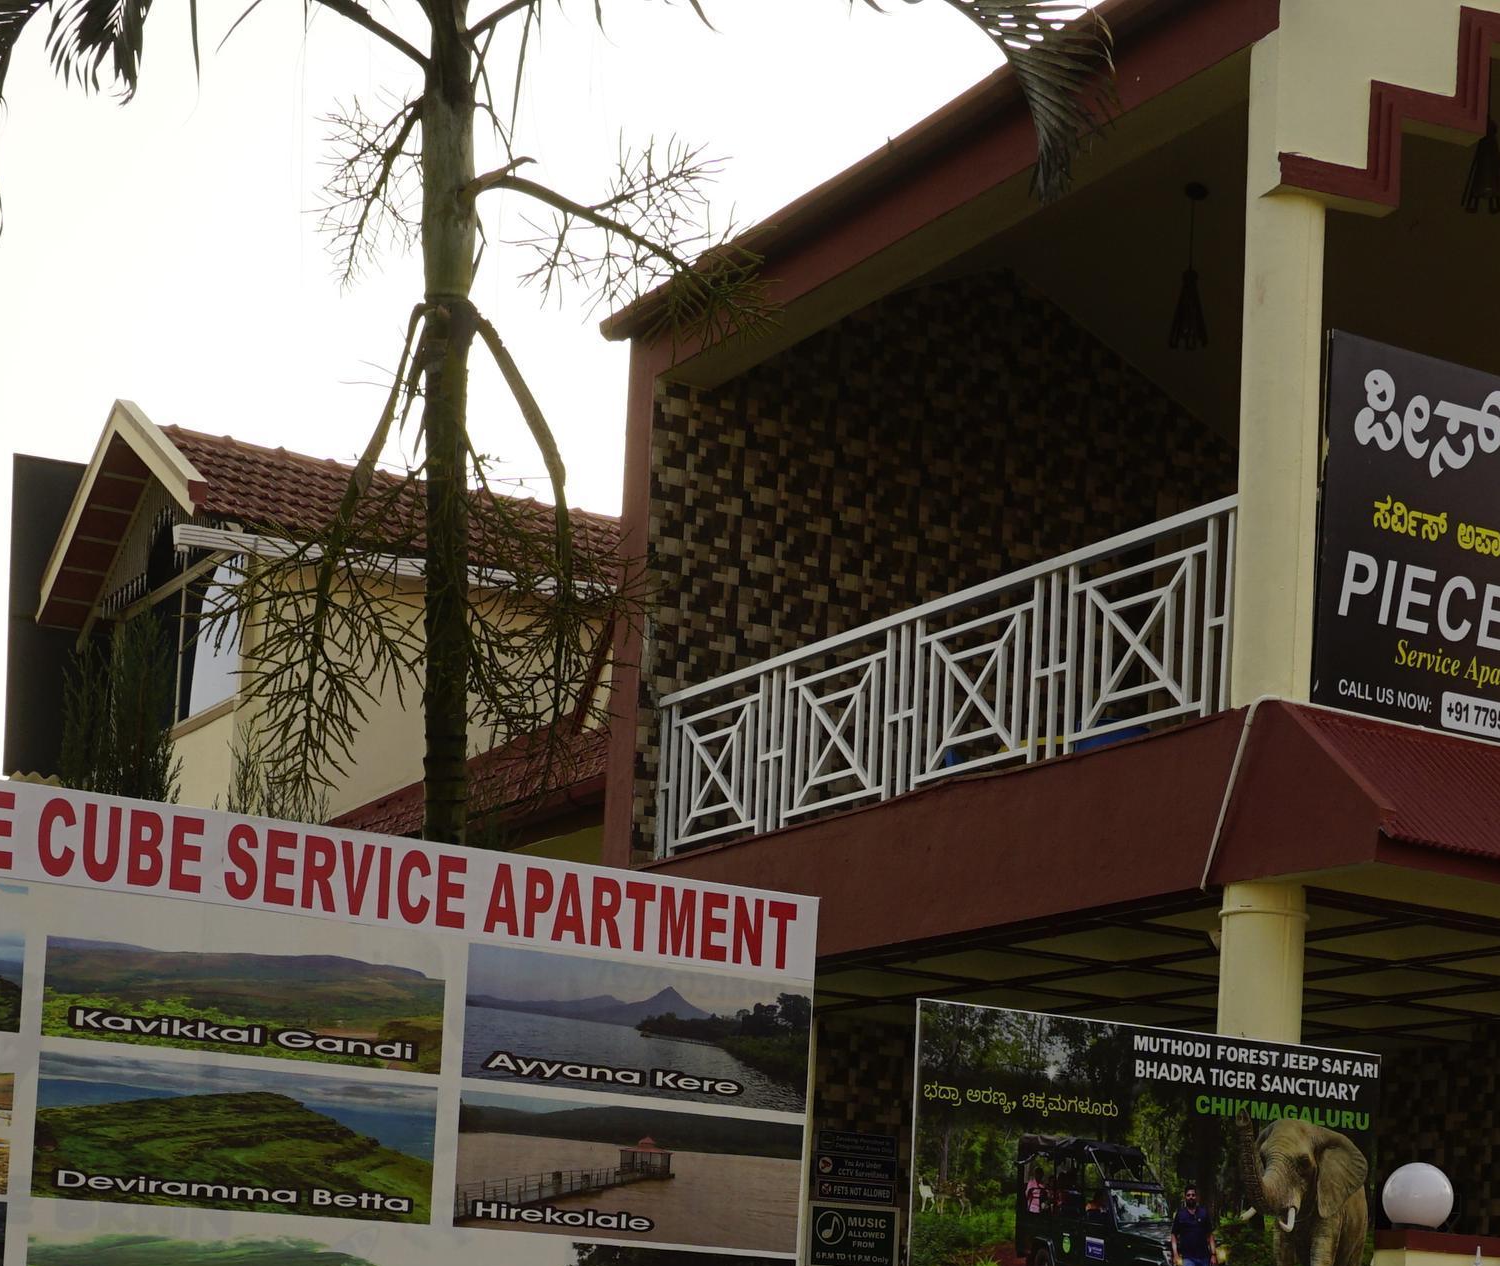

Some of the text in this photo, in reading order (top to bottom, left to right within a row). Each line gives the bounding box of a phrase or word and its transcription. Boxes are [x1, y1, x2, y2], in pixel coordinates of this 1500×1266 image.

[1373, 495, 1448, 542] ಸರ್ವಿಸ್
[1395, 639, 1461, 677] Service
[1338, 678, 1433, 714] CALL US NOW:
[1446, 701, 1470, 724] +91
[37, 797, 206, 894] CUBE
[223, 823, 468, 928] SERVICE
[484, 863, 798, 970] APARTMENT
[74, 1008, 414, 1062] Kavikkal Gandi
[487, 1052, 740, 1096] Ayyana Kere
[1133, 1035, 1379, 1078] MUTHODI FOREST JEEP SAFARI
[924, 1081, 961, 1106] ಭದ್ರಾ
[1135, 1060, 1360, 1101] BHADRA TIGER SANCTUARY
[1195, 1095, 1370, 1131] CHIKMAGALURU
[837, 1168, 853, 1176] CCTV
[56, 1169, 411, 1213] Deviramma Betta
[833, 1185, 891, 1199] PETS NOT ALLOWED
[475, 1201, 652, 1233] Hirekolale
[847, 1216, 887, 1229] MUSIC
[847, 1230, 886, 1239] ALLOWED
[871, 1256, 889, 1264] Only
